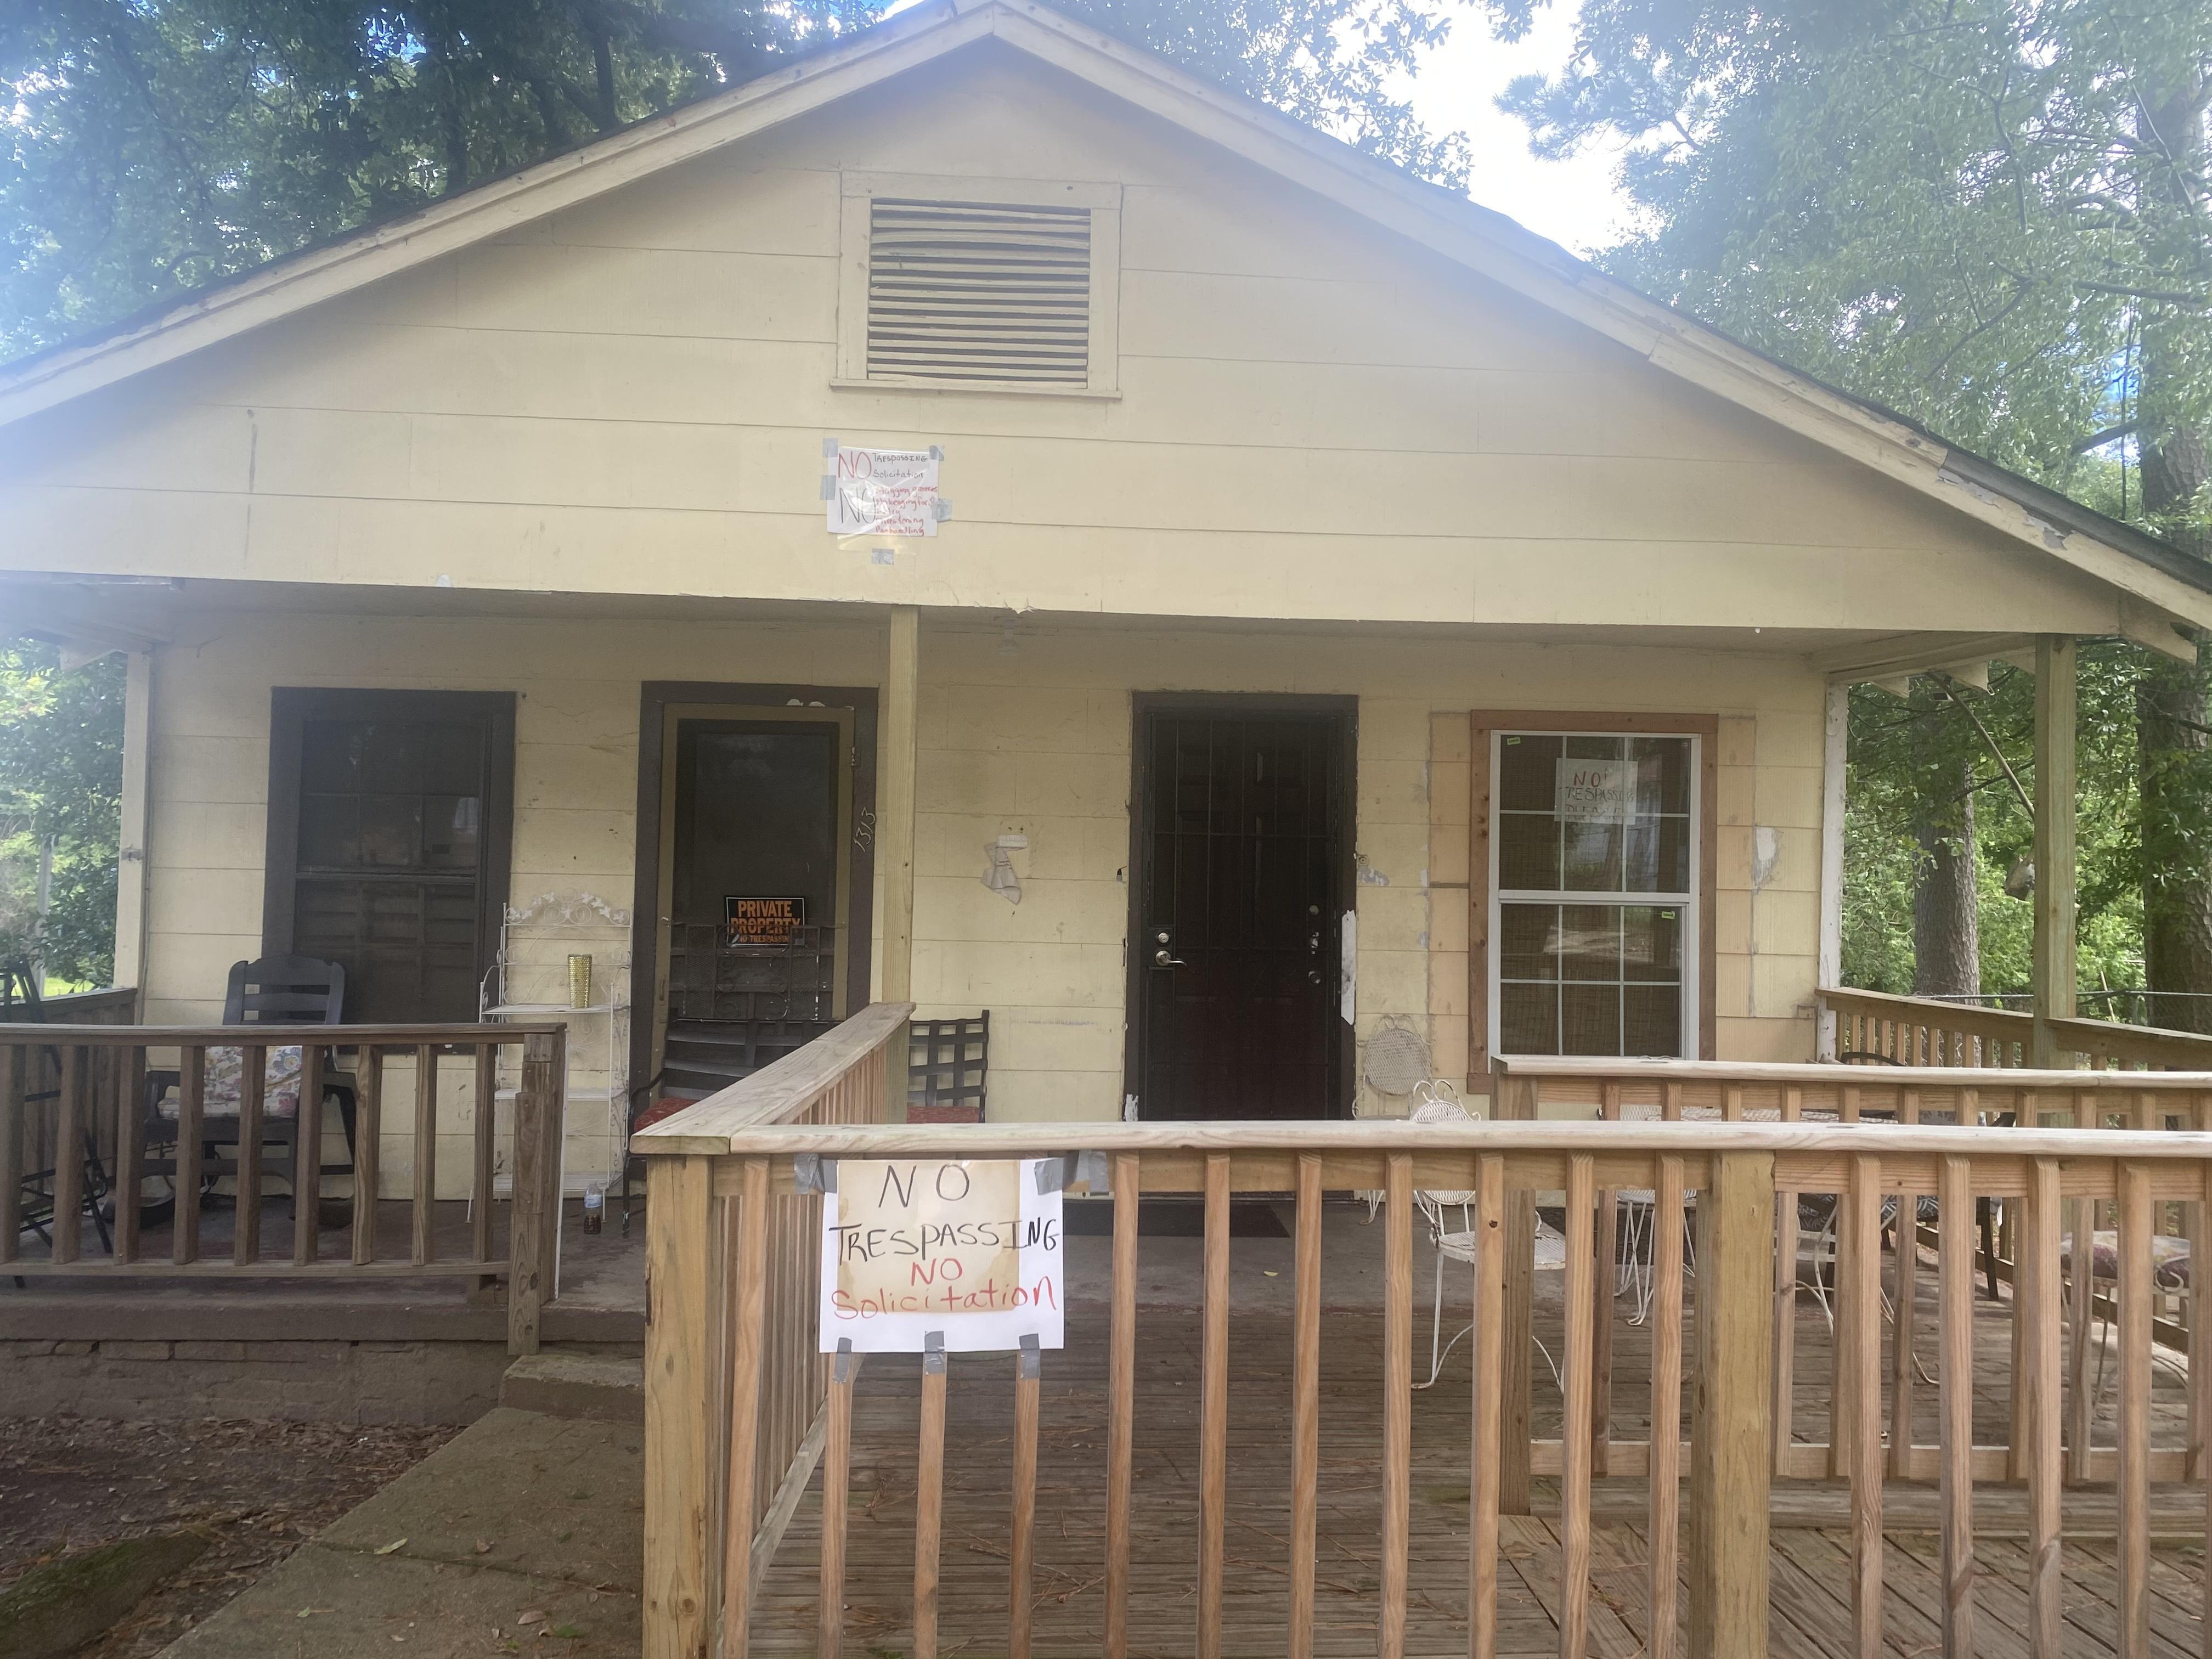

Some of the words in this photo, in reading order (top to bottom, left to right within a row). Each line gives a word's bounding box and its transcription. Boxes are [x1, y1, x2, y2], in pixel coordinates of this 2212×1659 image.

[838, 451, 872, 479] NO
[873, 470, 923, 478] Solicitation
[839, 487, 876, 524] NO
[853, 806, 876, 852] 1313
[737, 900, 792, 917] PRIVATE
[730, 917, 801, 934] PROPERTY
[749, 934, 791, 943] TRESPASSIN
[878, 1164, 969, 1207] NO
[829, 1217, 1060, 1266] TRESPASSING
[911, 1259, 962, 1286] NO
[832, 1276, 1056, 1319] Solicitation
